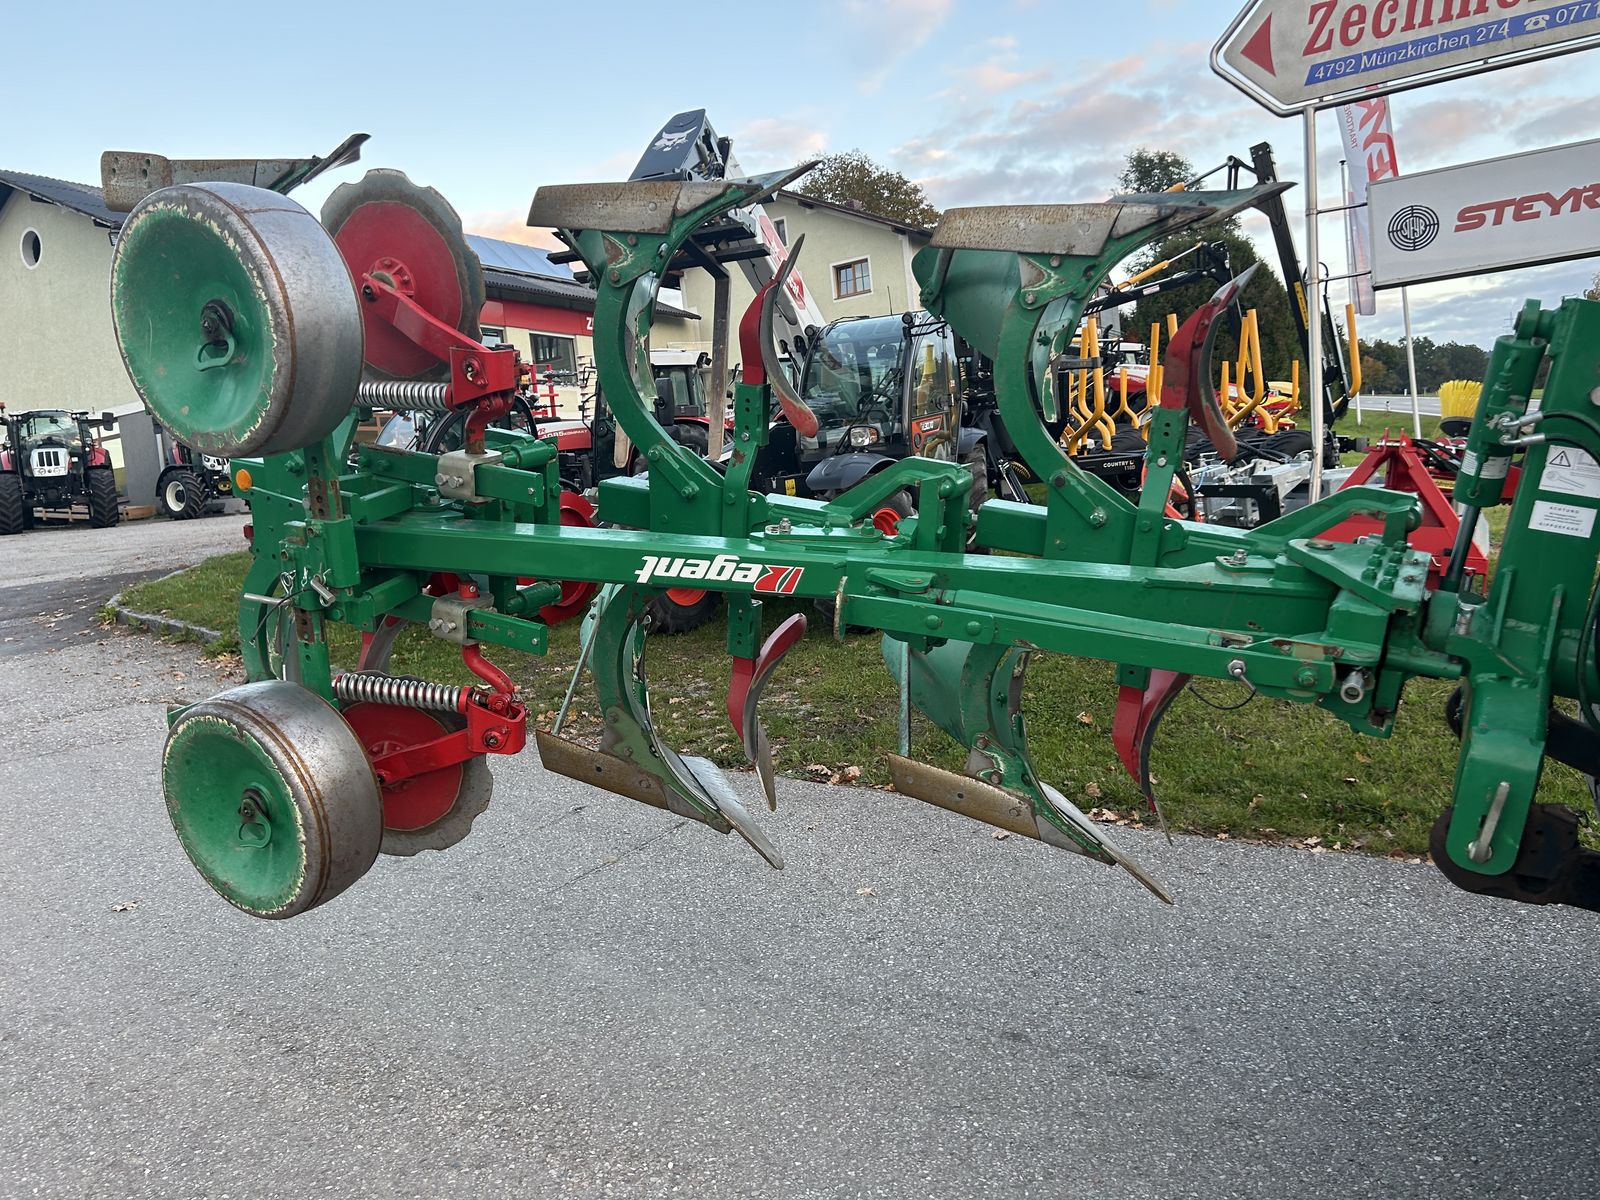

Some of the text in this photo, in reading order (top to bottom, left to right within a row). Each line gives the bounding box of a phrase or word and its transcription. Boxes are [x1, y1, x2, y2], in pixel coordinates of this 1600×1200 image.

[1302, 0, 1537, 56] Zechm
[1314, 58, 1356, 79] 4792
[1360, 34, 1470, 71] Münzkirchen
[1476, 20, 1510, 42] 274
[634, 554, 805, 594] Regent
